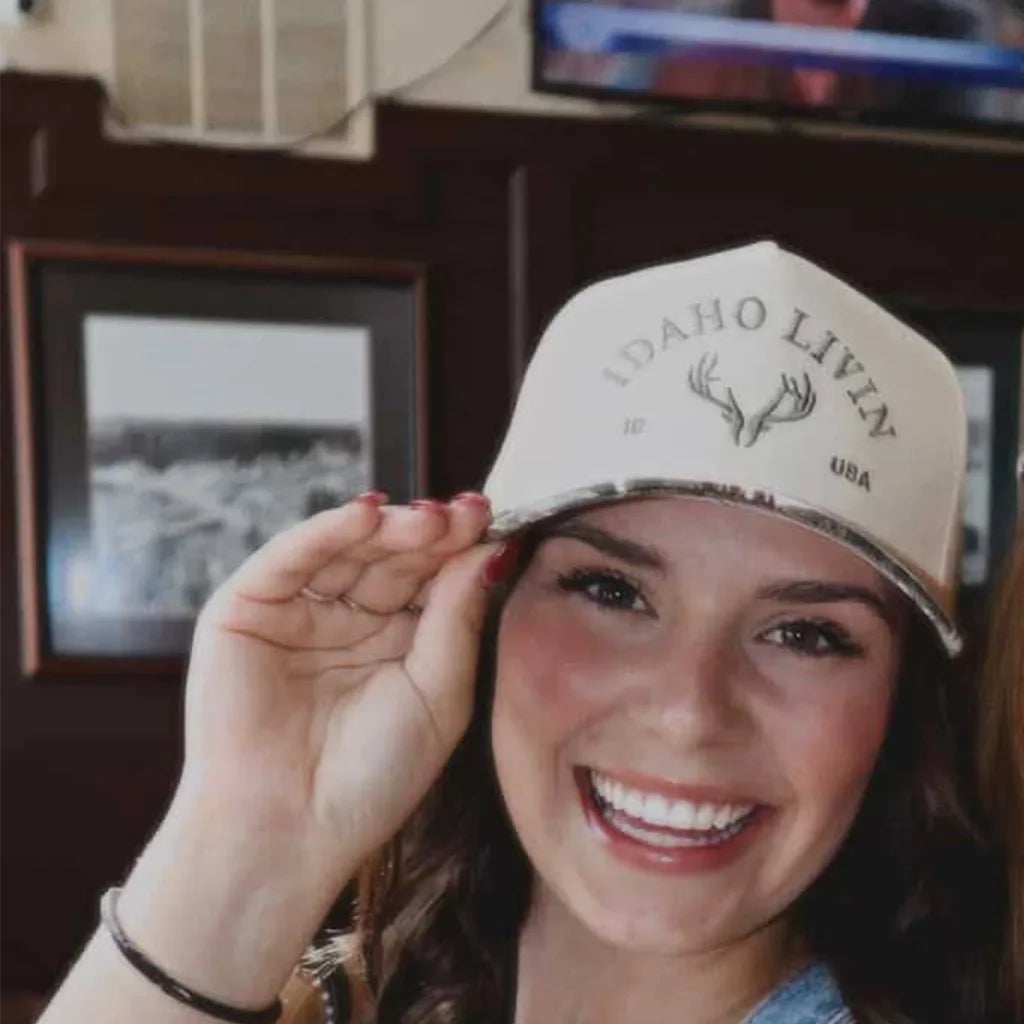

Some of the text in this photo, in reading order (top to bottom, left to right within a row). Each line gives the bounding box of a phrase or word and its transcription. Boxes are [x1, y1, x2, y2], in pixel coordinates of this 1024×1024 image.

[603, 296, 896, 438] IDAHO LIVIN
[830, 455, 871, 493] USA
